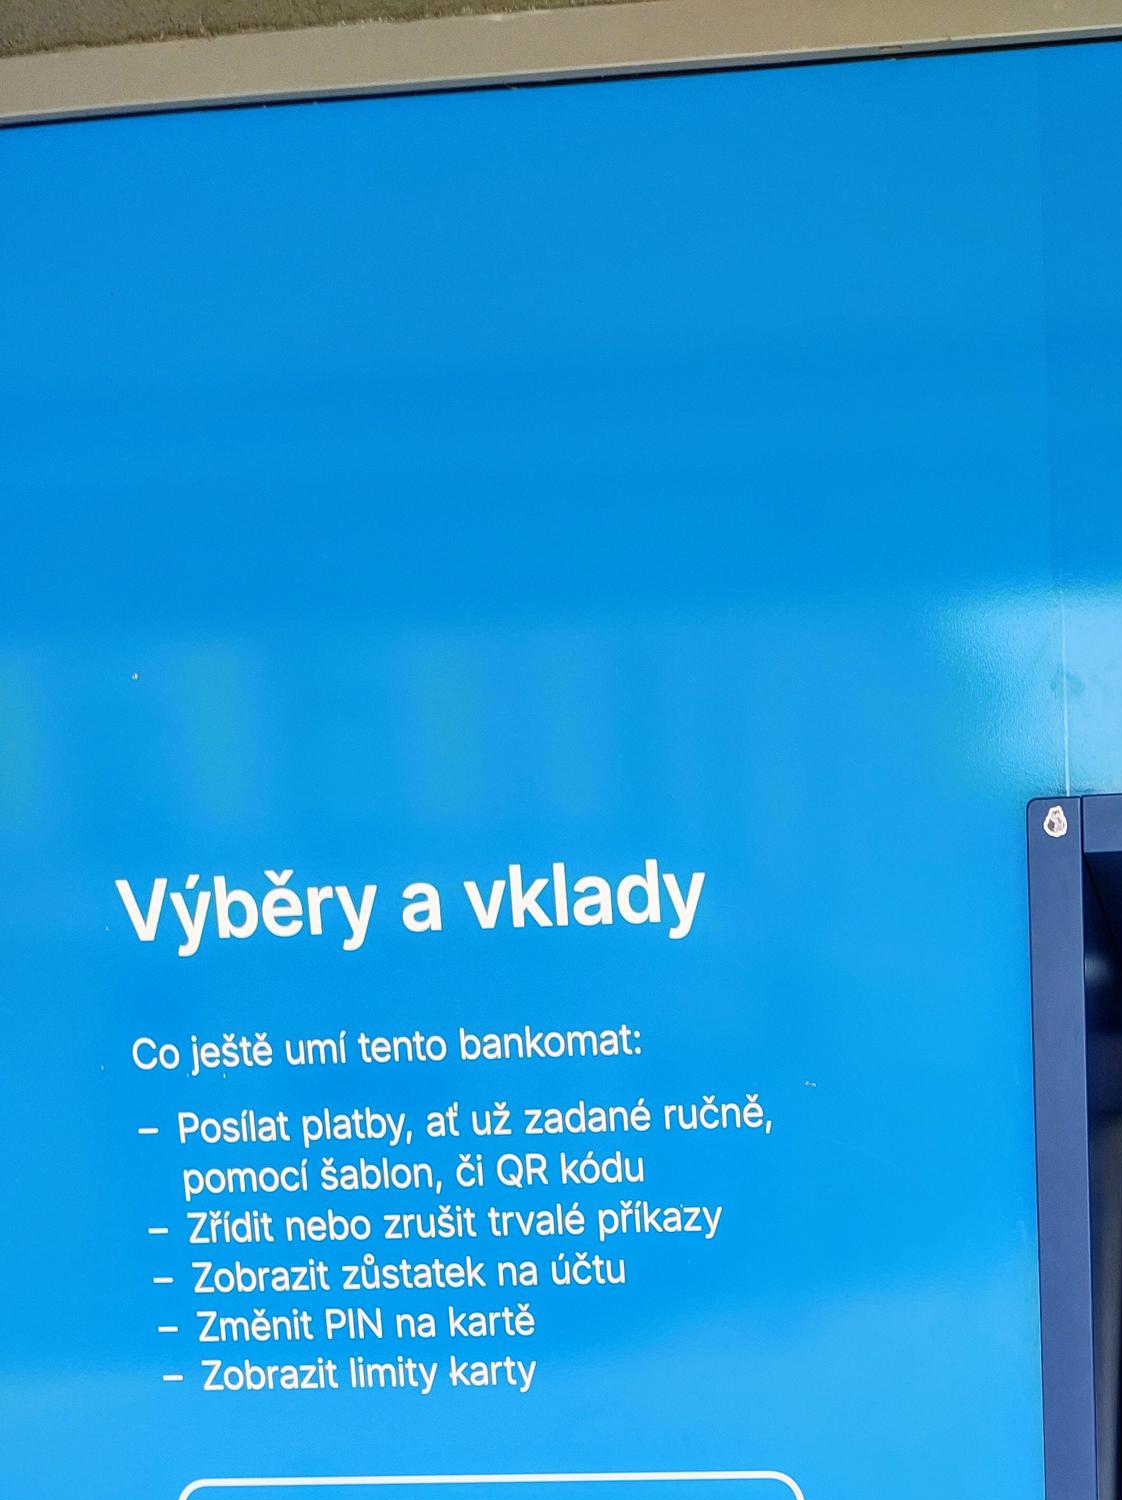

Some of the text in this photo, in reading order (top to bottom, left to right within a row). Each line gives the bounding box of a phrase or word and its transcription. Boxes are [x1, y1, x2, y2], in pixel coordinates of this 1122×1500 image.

[115, 858, 706, 957] Výběry a vklady
[132, 1024, 641, 1076] Co ještě umí tento bankomat:
[177, 1109, 291, 1144] Posílat
[302, 1107, 413, 1149] platby,
[426, 1102, 460, 1137] ať
[471, 1101, 512, 1136] už
[524, 1098, 651, 1134] zadané
[664, 1093, 772, 1134] ručně,
[183, 1150, 644, 1202] pomocí šablon, či QR kódu
[187, 1210, 275, 1244] Zřídit
[285, 1209, 371, 1242] nebo
[383, 1204, 477, 1239] zrušit
[487, 1202, 585, 1237] trvalé
[598, 1200, 723, 1242] příkazy
[191, 1258, 330, 1293] Zobrazit
[341, 1253, 487, 1290] zůstatek
[497, 1261, 538, 1286] na
[551, 1251, 626, 1285] účtu
[196, 1308, 314, 1342] Změnit
[325, 1307, 383, 1340] PIN
[396, 1313, 436, 1338] na
[448, 1303, 535, 1337] kartě
[201, 1357, 339, 1391] Zobrazit
[349, 1355, 438, 1395] limity
[448, 1355, 537, 1393] karty
